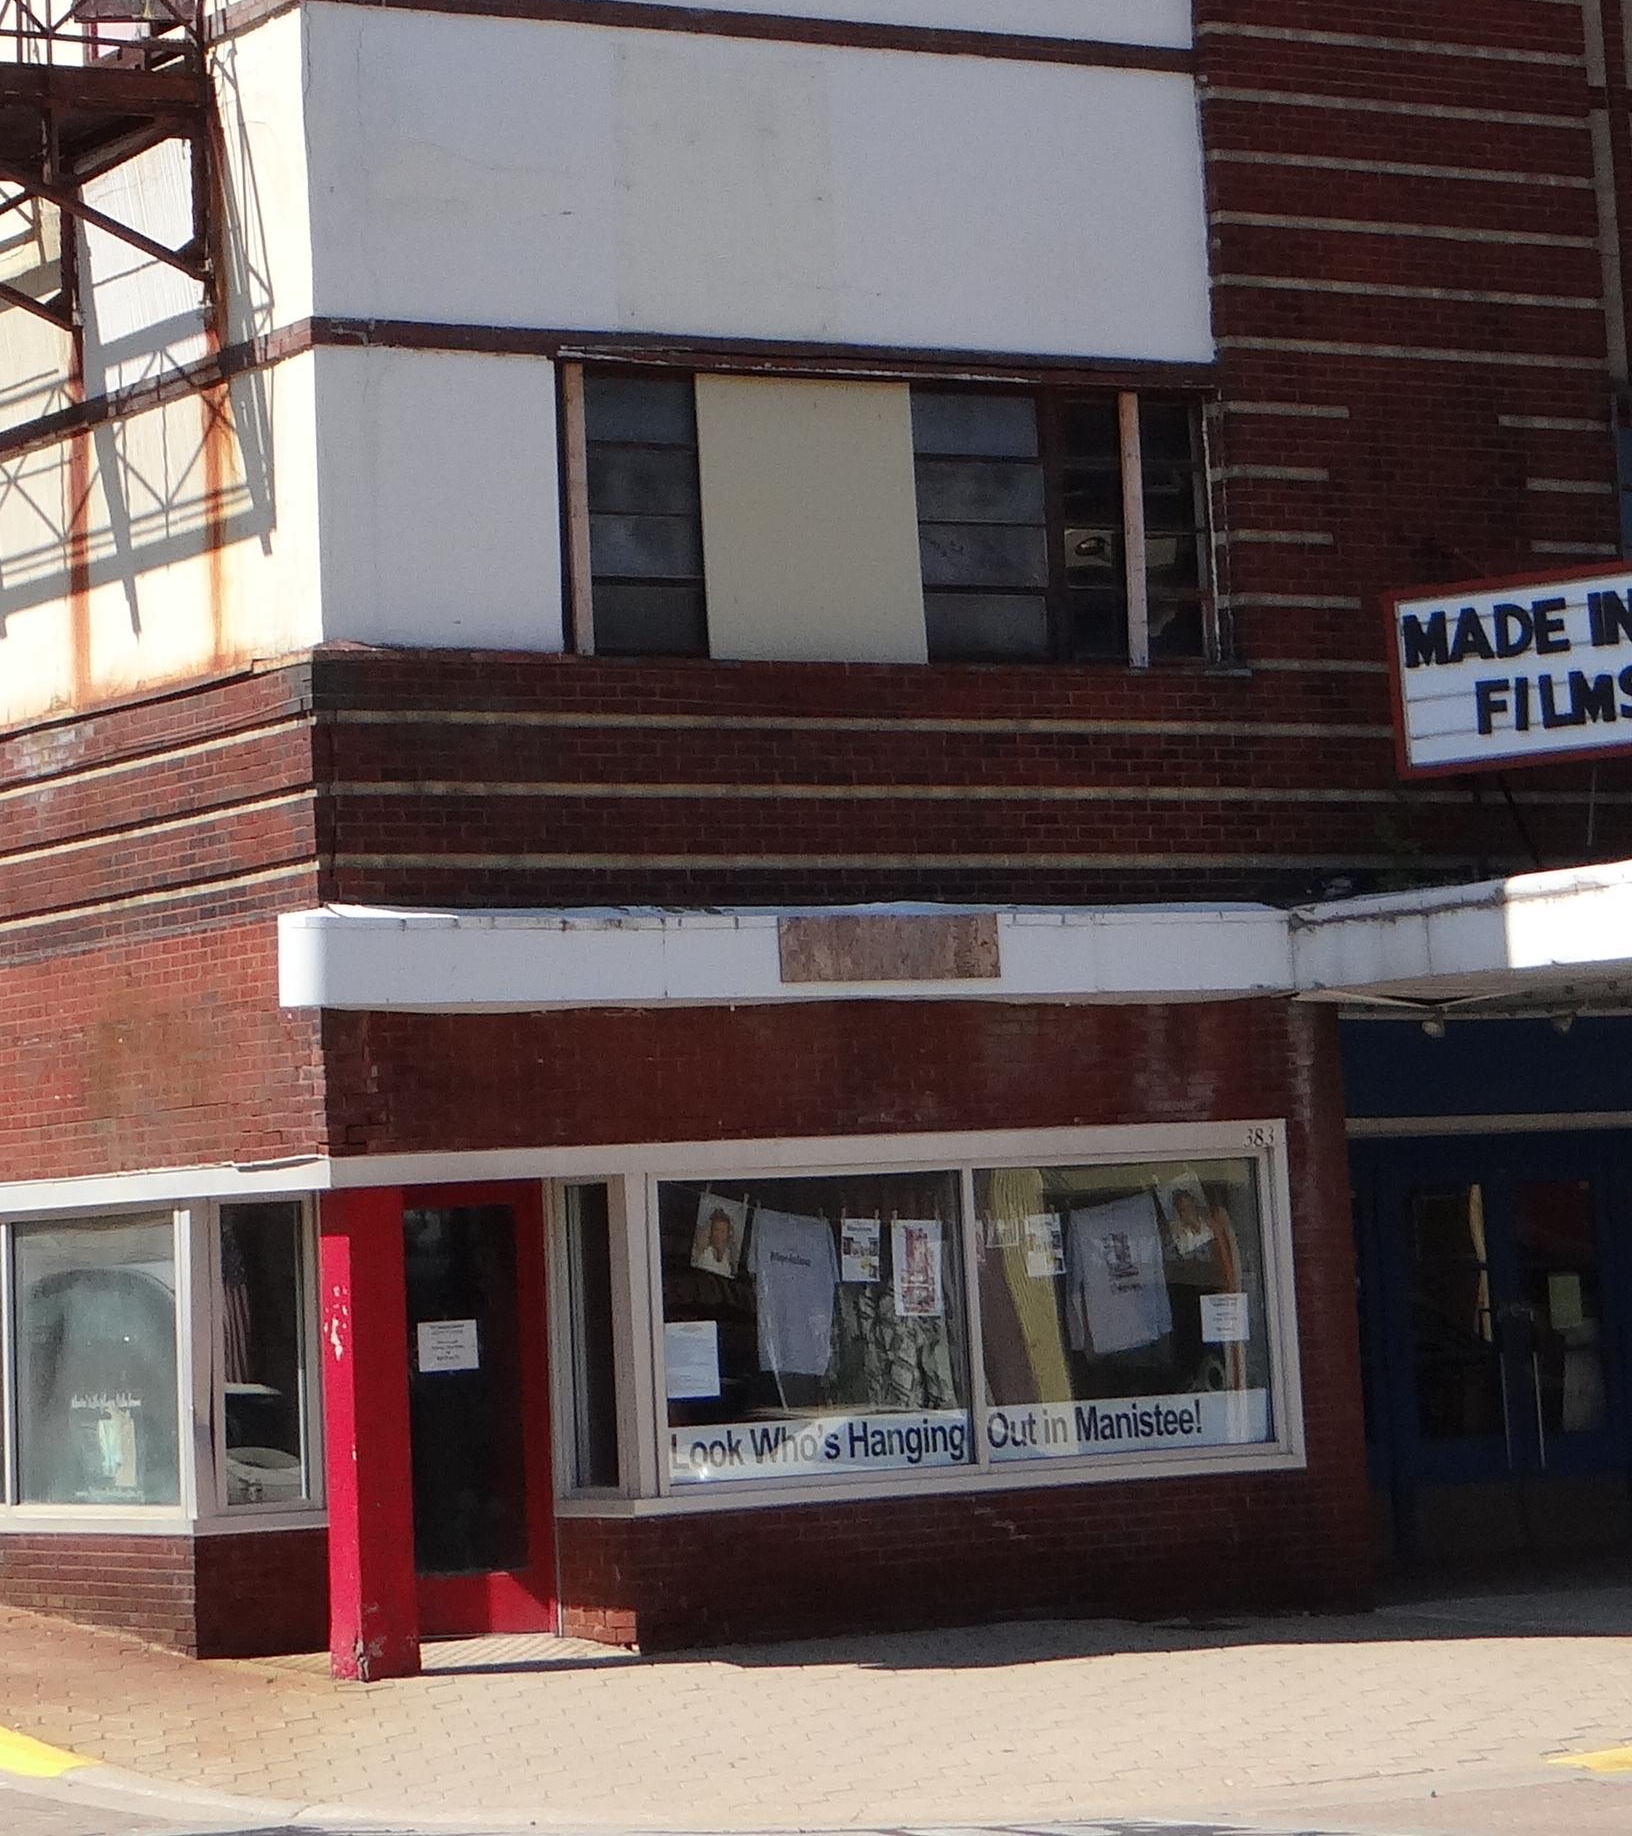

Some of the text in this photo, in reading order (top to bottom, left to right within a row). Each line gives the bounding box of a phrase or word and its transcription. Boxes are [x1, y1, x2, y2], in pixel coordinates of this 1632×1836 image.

[1401, 596, 1572, 670] MADE
[1243, 1126, 1275, 1148] 383
[670, 1417, 966, 1470] Look Who's Hanging
[986, 1398, 1203, 1449] Out in Manistee!
